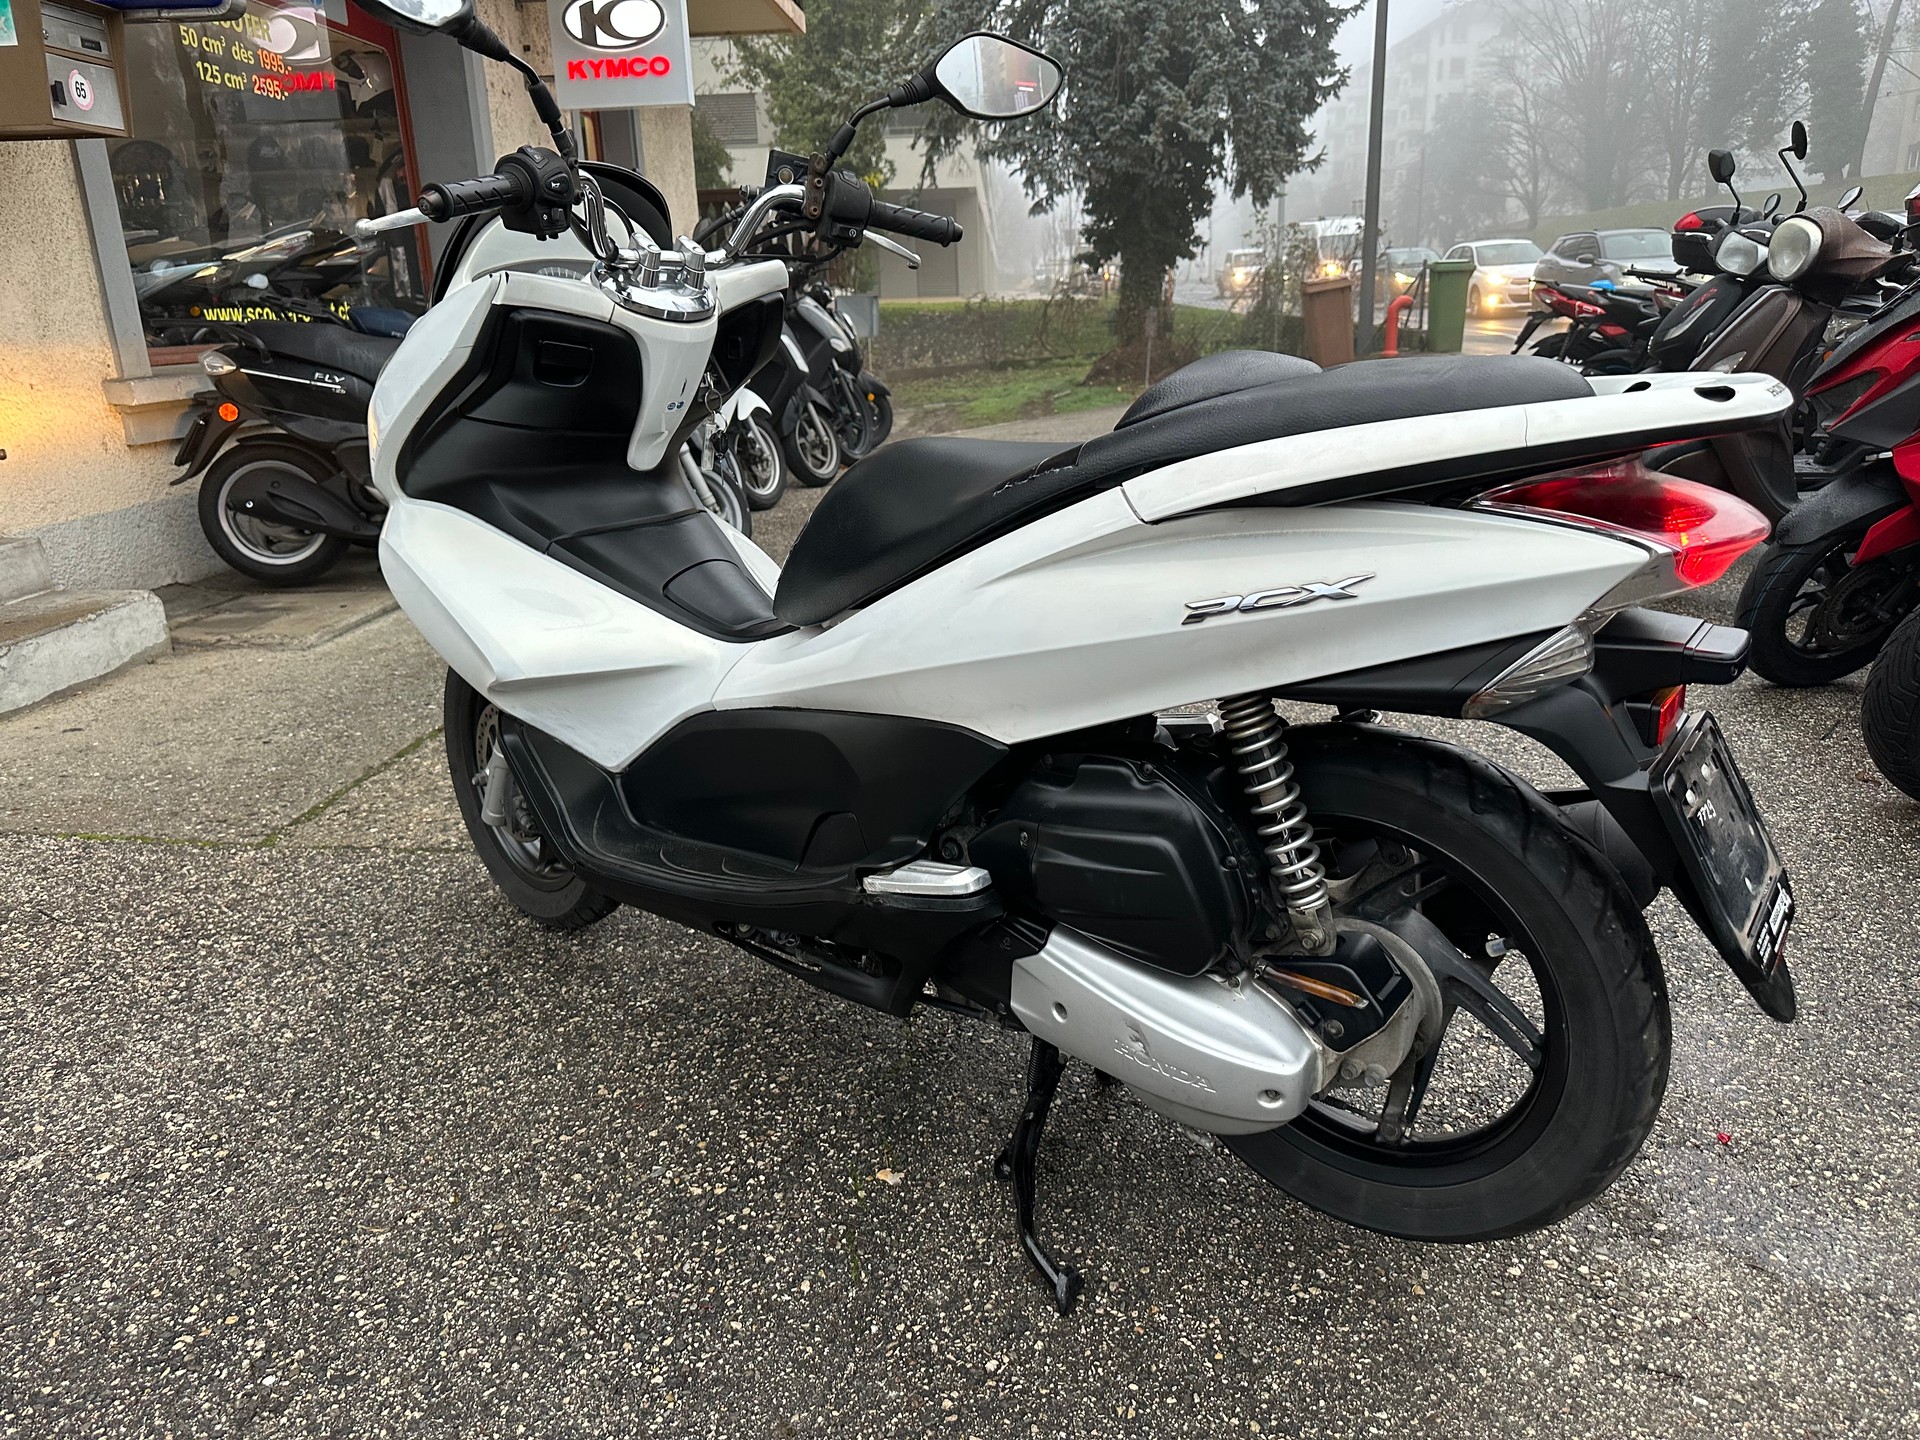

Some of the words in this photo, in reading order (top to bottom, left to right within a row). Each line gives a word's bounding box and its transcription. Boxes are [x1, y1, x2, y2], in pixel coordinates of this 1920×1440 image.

[179, 25, 198, 48] 50
[232, 41, 254, 65] dès
[257, 48, 292, 75] 1995.-
[567, 55, 671, 80] KYMCO
[75, 80, 87, 99] 65
[196, 61, 221, 85] 125
[252, 74, 289, 101] 2595.-
[314, 372, 346, 383] FLY
[1181, 573, 1375, 625] PCX
[1113, 1039, 1217, 1093] HONDA
